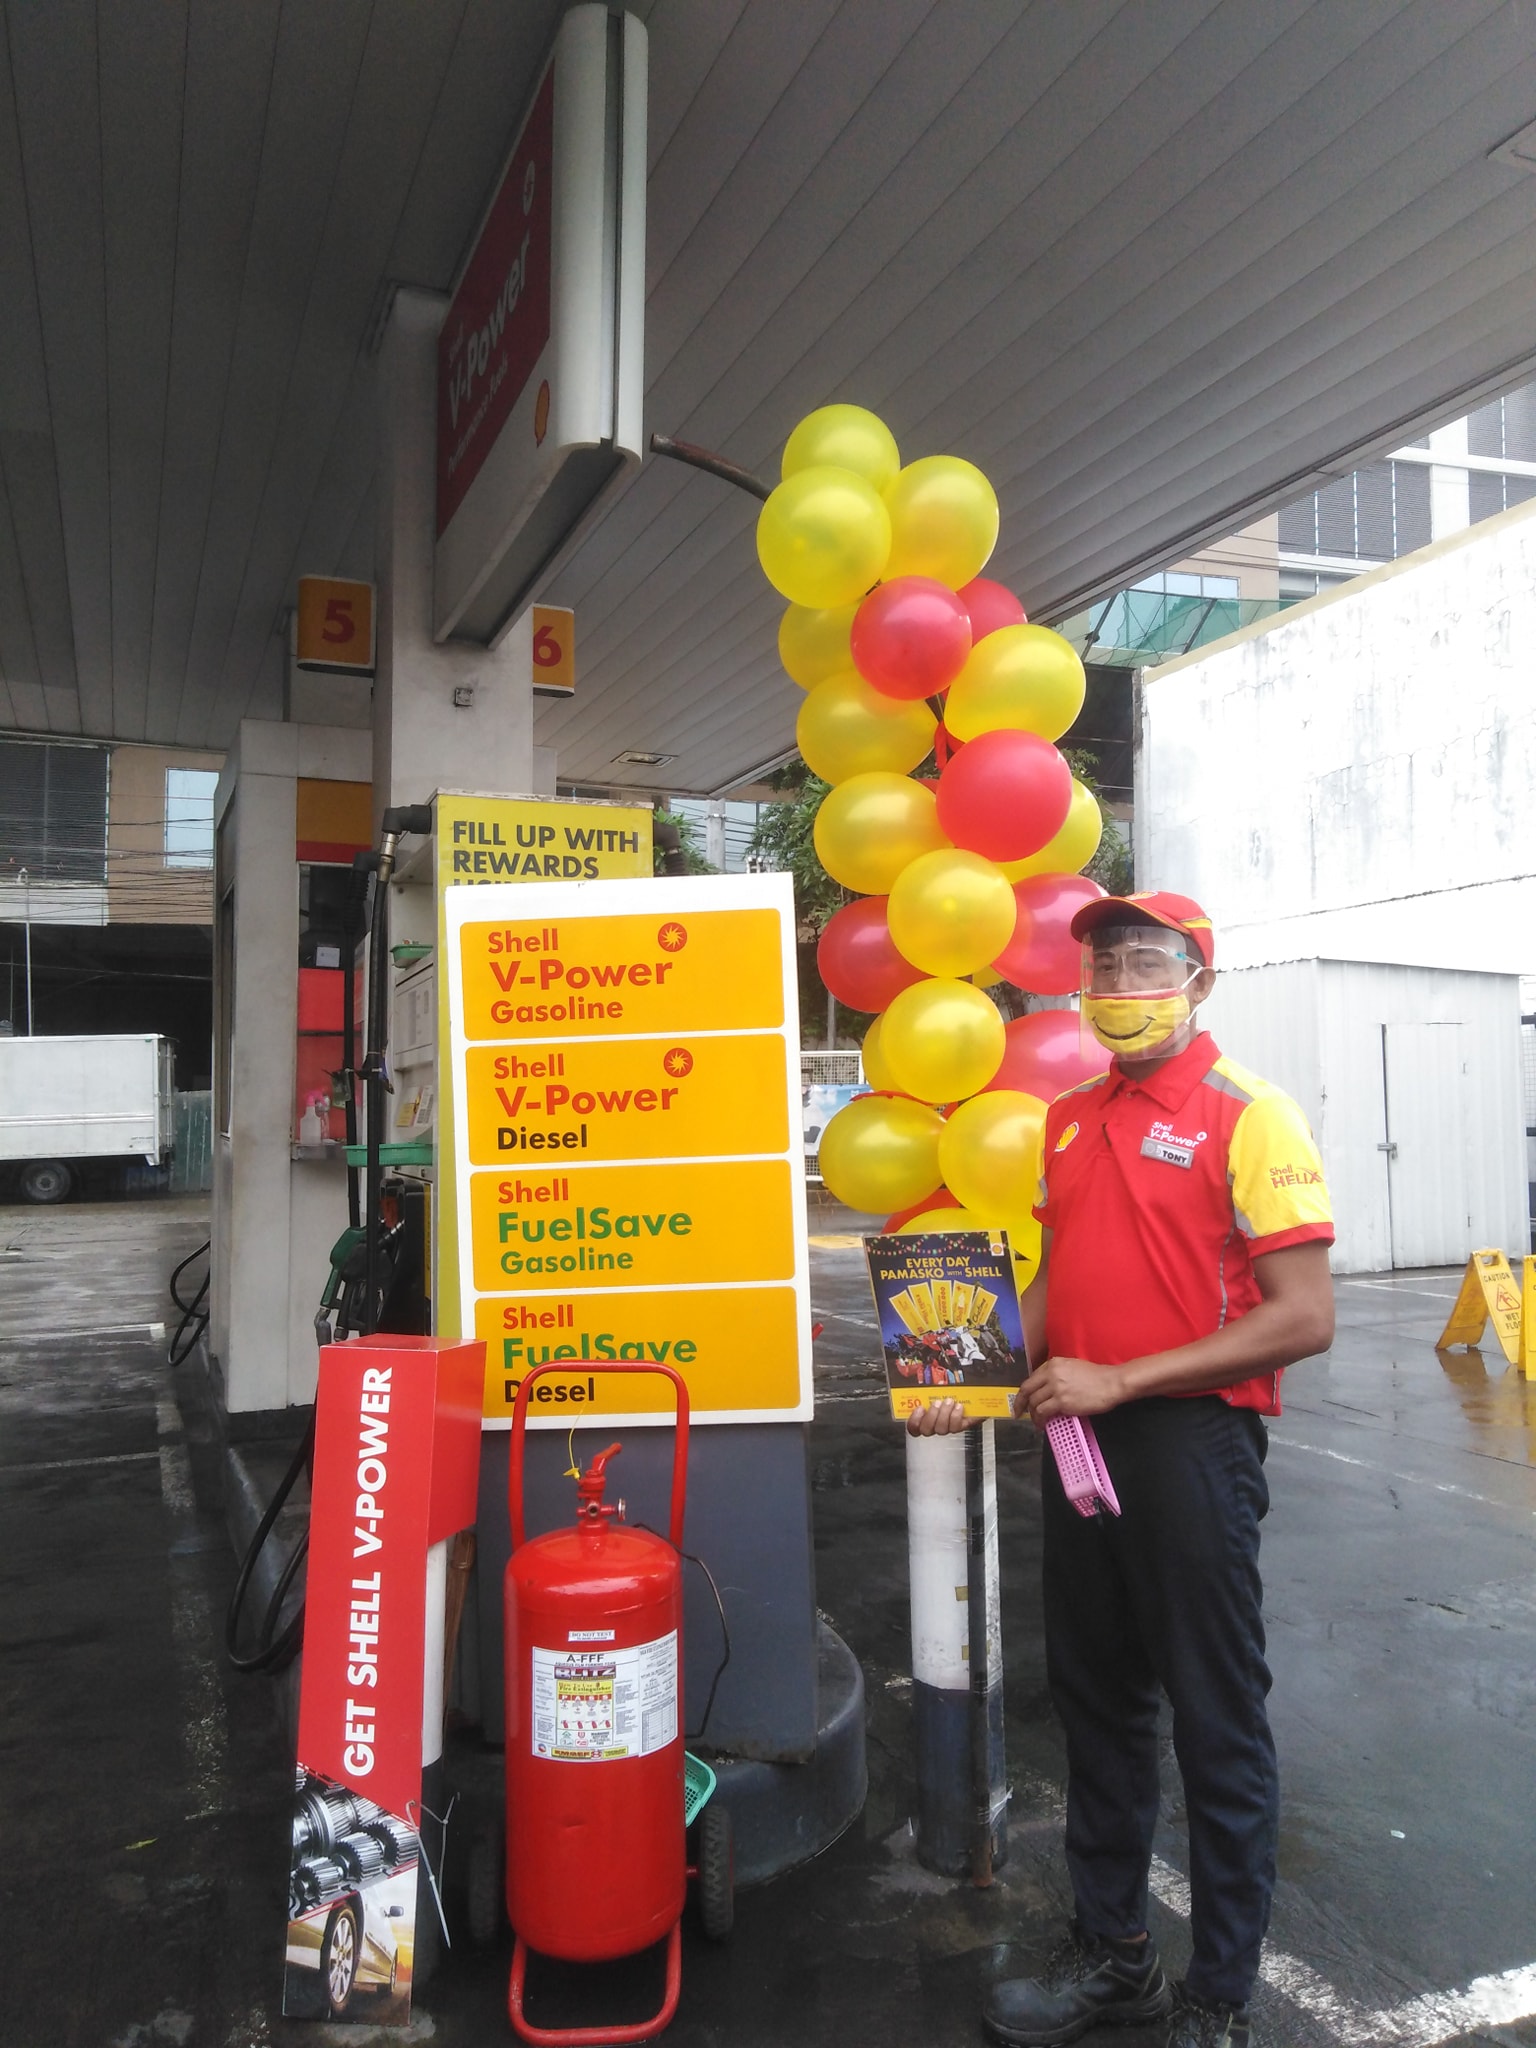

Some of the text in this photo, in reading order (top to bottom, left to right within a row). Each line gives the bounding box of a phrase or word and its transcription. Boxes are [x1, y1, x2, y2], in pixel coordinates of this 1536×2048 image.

[450, 228, 531, 430] V-Power
[322, 600, 355, 643] 5
[533, 626, 562, 667] 6
[453, 821, 639, 853] FILL UP WITH
[453, 850, 599, 879] REWARDS
[488, 928, 559, 954] Shell
[489, 959, 673, 992] V-Power
[490, 996, 623, 1024] Gasoline
[493, 1054, 565, 1079] Shell
[495, 1085, 679, 1118] V-Power
[497, 1124, 587, 1150] Diesel
[1150, 1128, 1199, 1148] V-Power
[1152, 1121, 1174, 1131] Shell
[1162, 1150, 1187, 1164] TONY
[1269, 1164, 1293, 1177] Shell
[1271, 1171, 1324, 1188] HELIX
[498, 1178, 569, 1204] Shell
[498, 1206, 692, 1243] FuelSave
[500, 1247, 633, 1275] Gasoline
[880, 1268, 945, 1280] PAMASKO
[965, 1267, 1002, 1277] SHELL
[906, 1256, 970, 1268] EVERY DAY
[1484, 1272, 1510, 1282] CAUTION
[502, 1304, 574, 1330] Shell
[1505, 1312, 1519, 1321] WET
[503, 1333, 697, 1369] FuelSave
[343, 1367, 393, 1776] GET SHELL V-POWER
[567, 1654, 604, 1663] A-FFF
[555, 1667, 615, 1679] BLITZ
